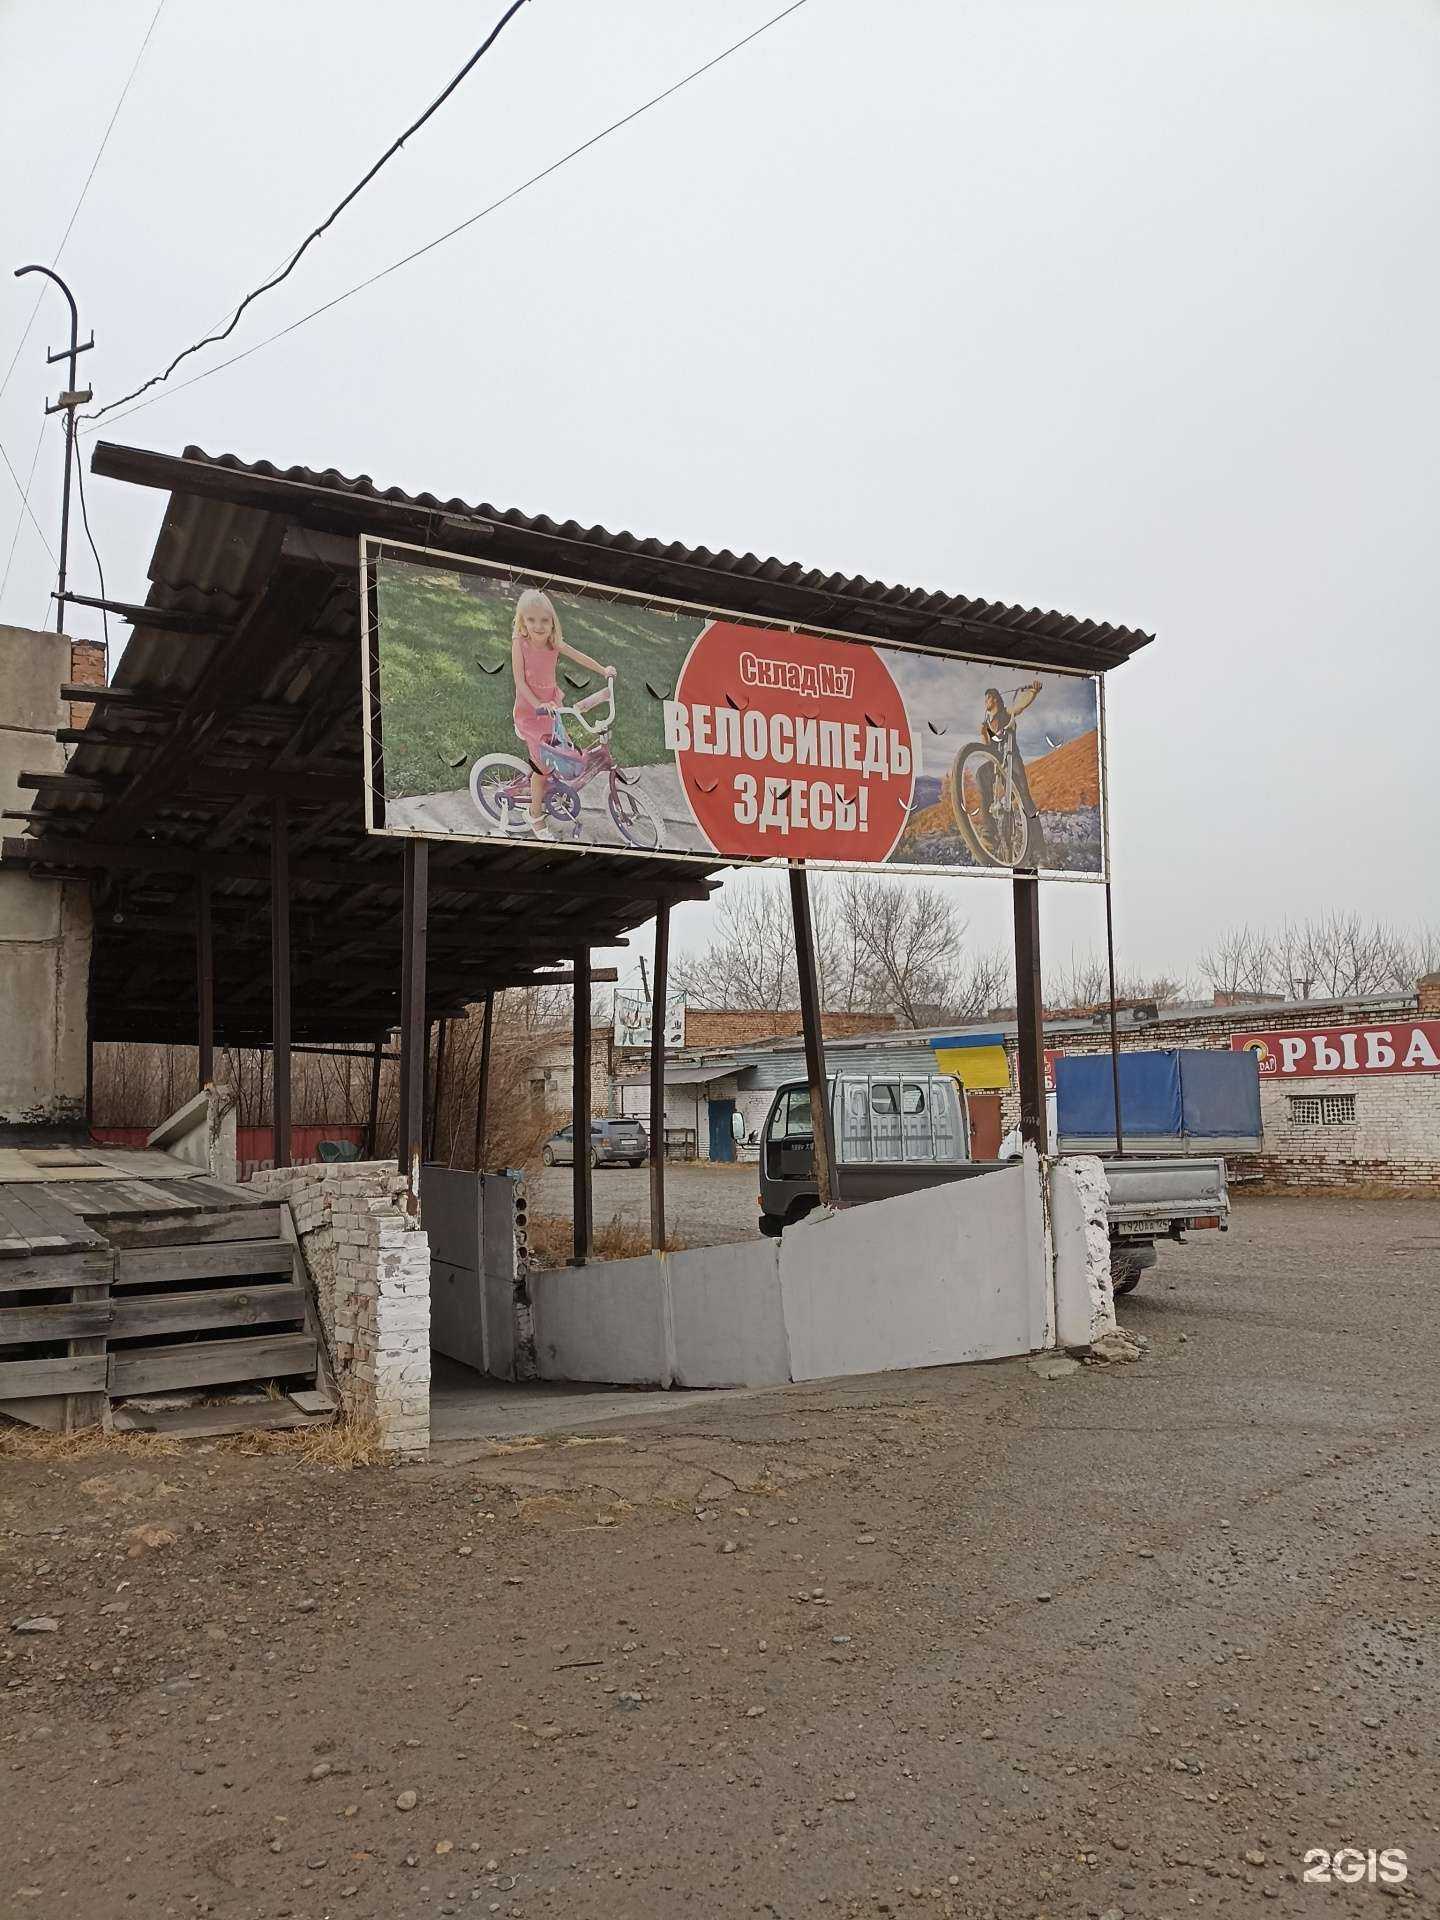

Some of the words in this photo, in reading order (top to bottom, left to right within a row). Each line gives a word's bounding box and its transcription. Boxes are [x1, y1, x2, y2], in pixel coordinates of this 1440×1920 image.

[740, 652, 819, 698] Склад
[820, 664, 855, 699] №7
[663, 699, 923, 781] ВЕЛОСИПЕДЫ
[733, 773, 869, 835] ЗДЕСЬ!
[1279, 1028, 1440, 1073] РЫБА
